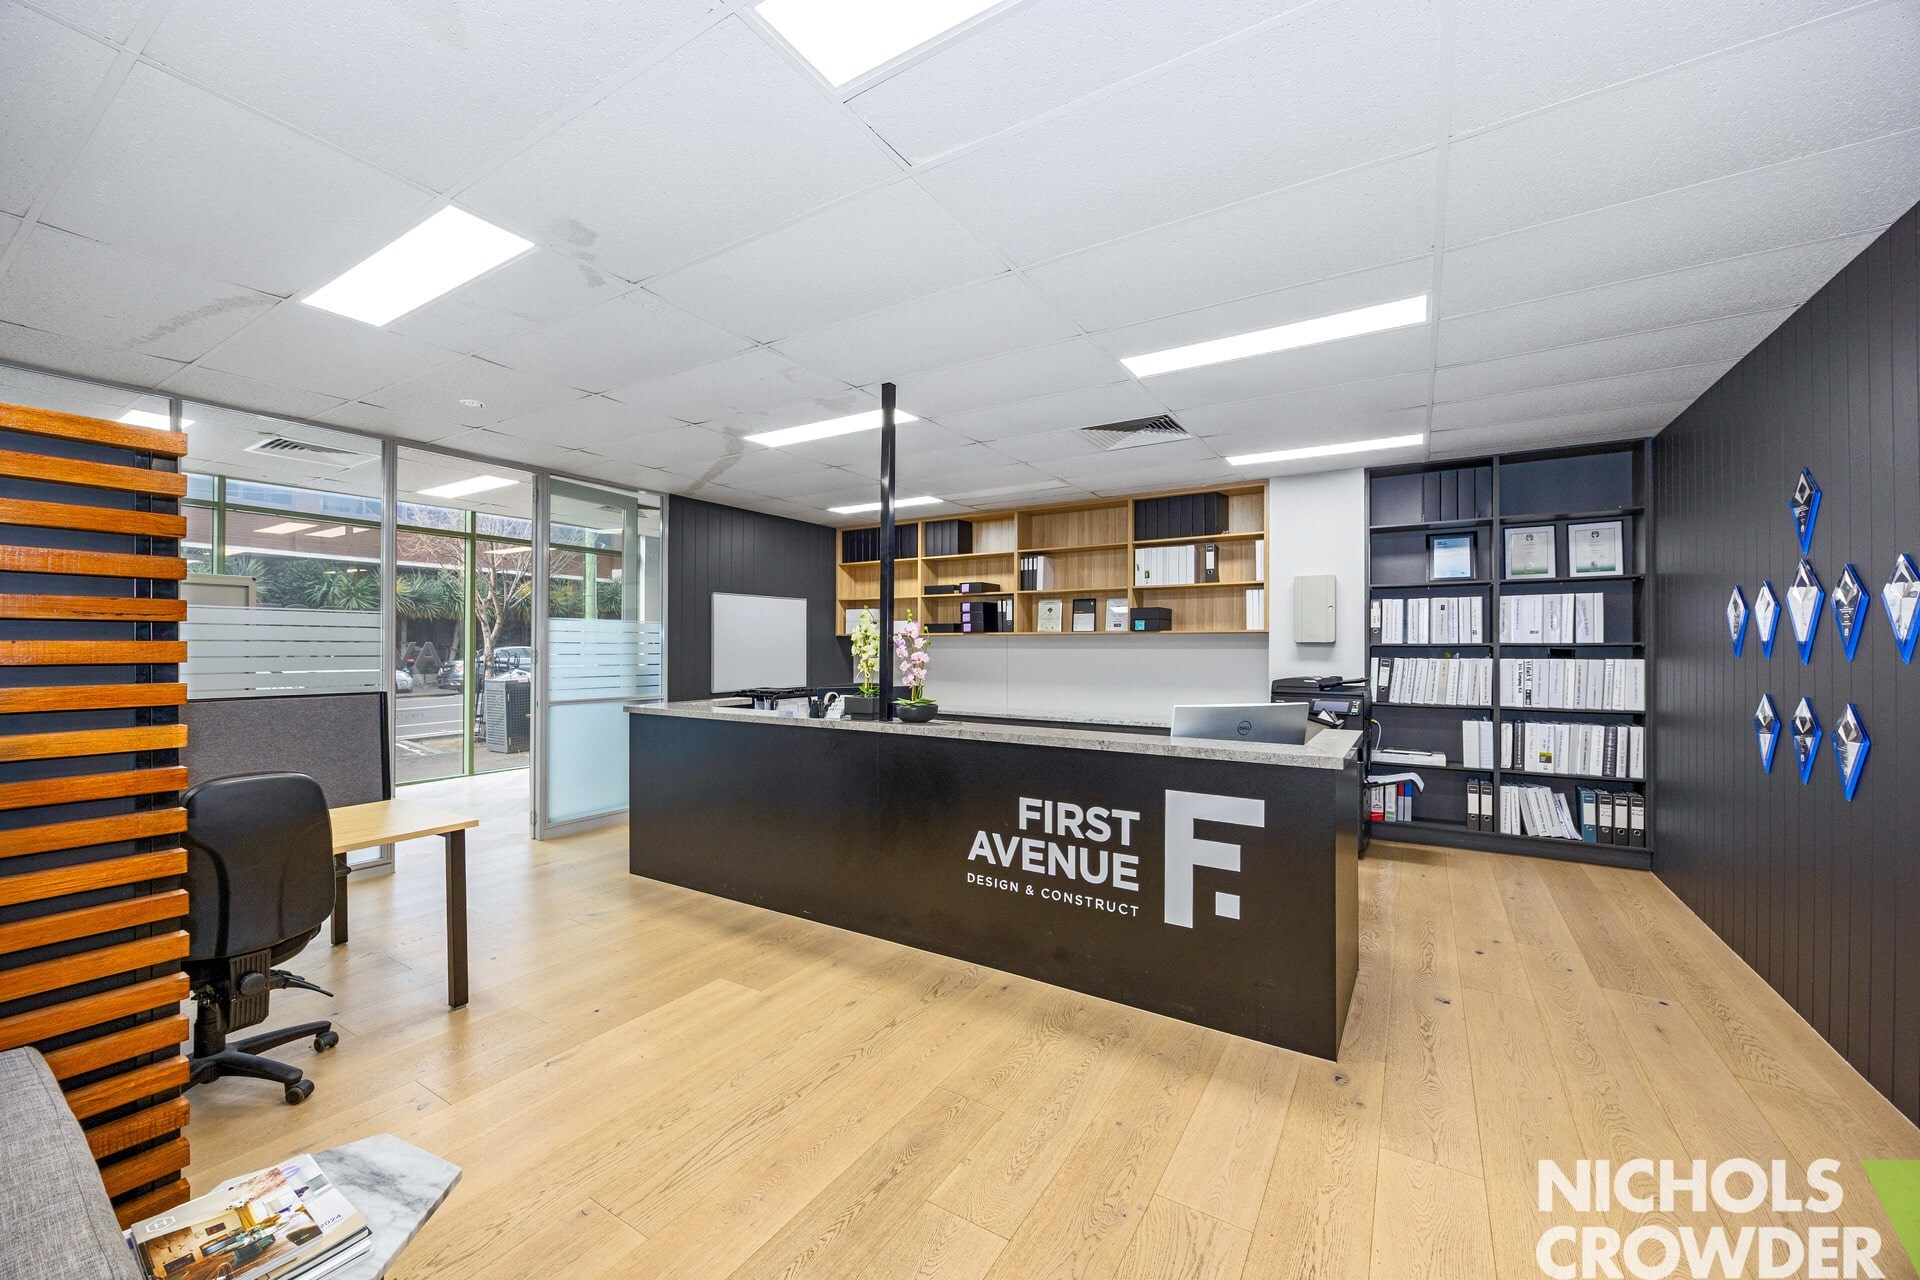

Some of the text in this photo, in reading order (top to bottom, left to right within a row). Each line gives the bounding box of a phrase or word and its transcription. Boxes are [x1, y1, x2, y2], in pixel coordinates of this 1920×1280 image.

[1018, 796, 1141, 847] FIRST
[967, 830, 1140, 892] AVENUE
[967, 872, 1140, 917] DESIGN & CONSTRUCT
